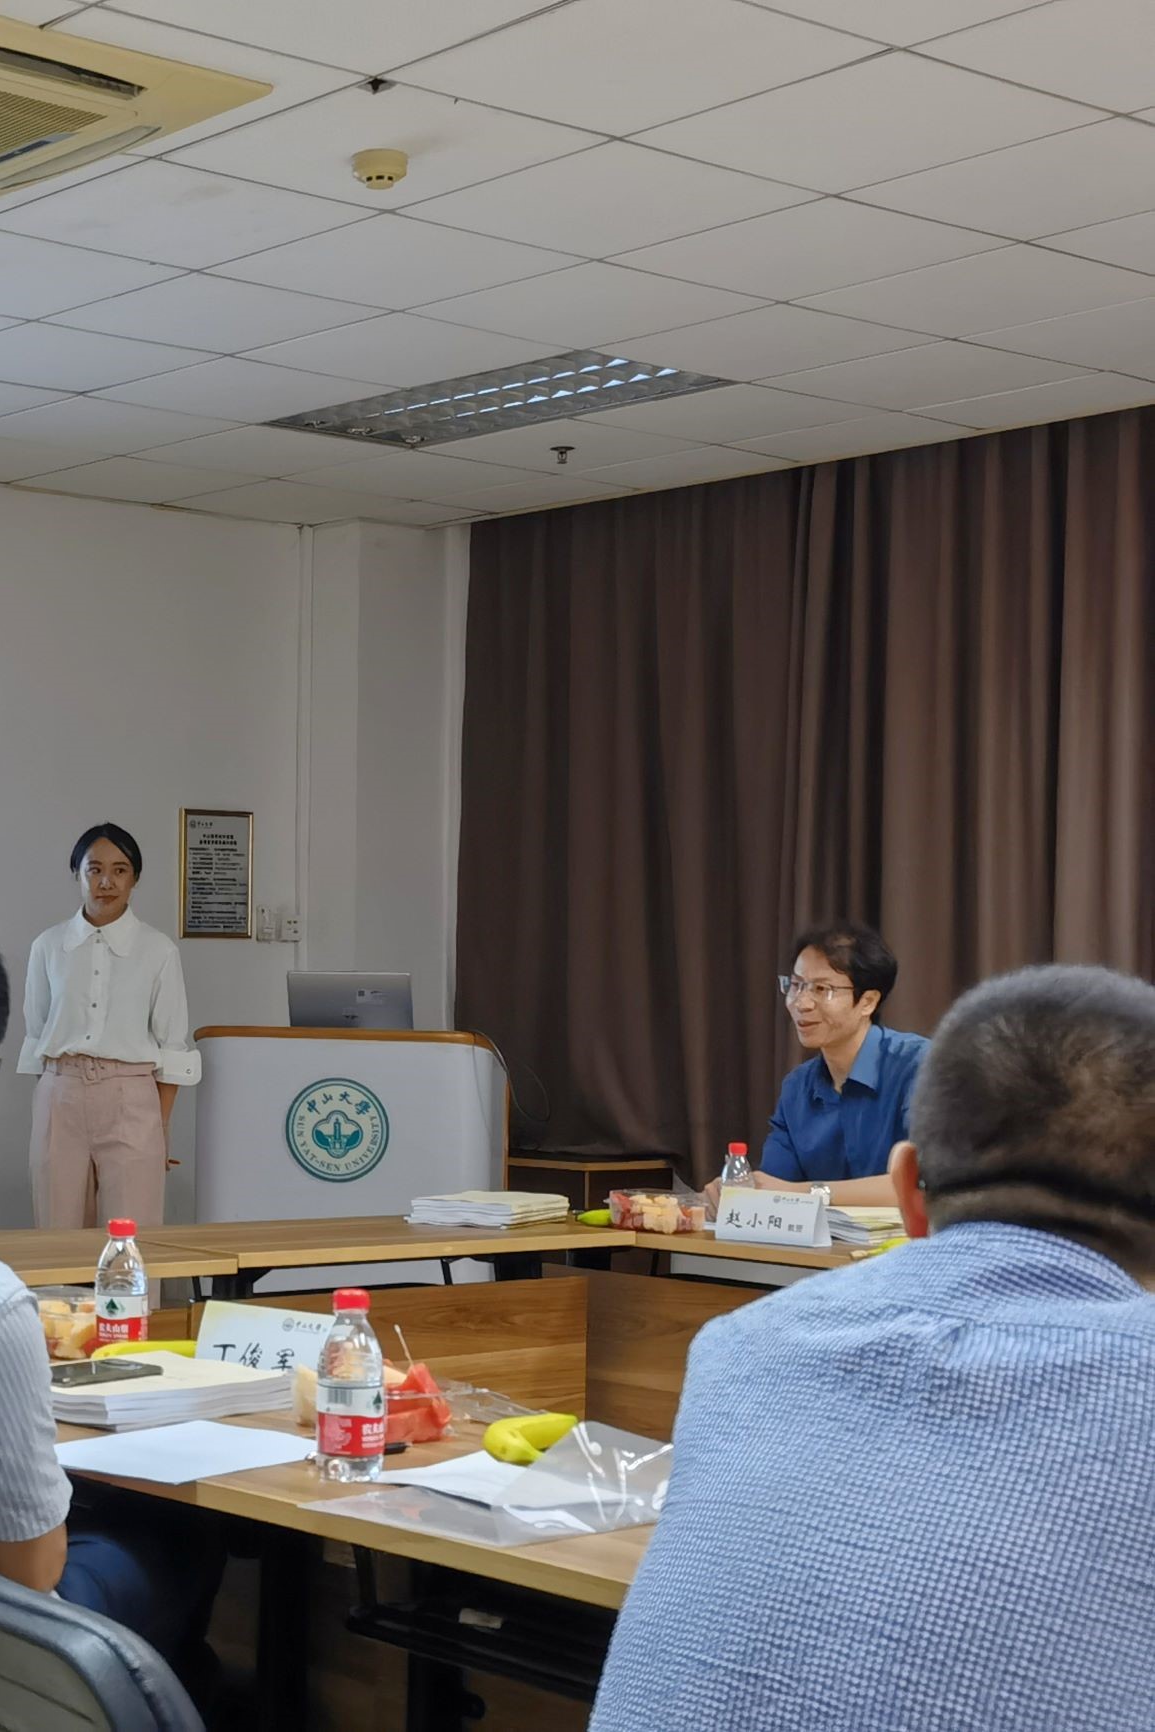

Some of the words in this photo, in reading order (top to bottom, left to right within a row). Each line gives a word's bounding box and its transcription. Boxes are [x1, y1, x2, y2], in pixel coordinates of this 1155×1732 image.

[296, 1115, 305, 1137] SUN
[345, 1115, 380, 1171] UNIVERSITY
[299, 1141, 341, 1172] YAT-SEN
[725, 1209, 783, 1230] 赵小阳
